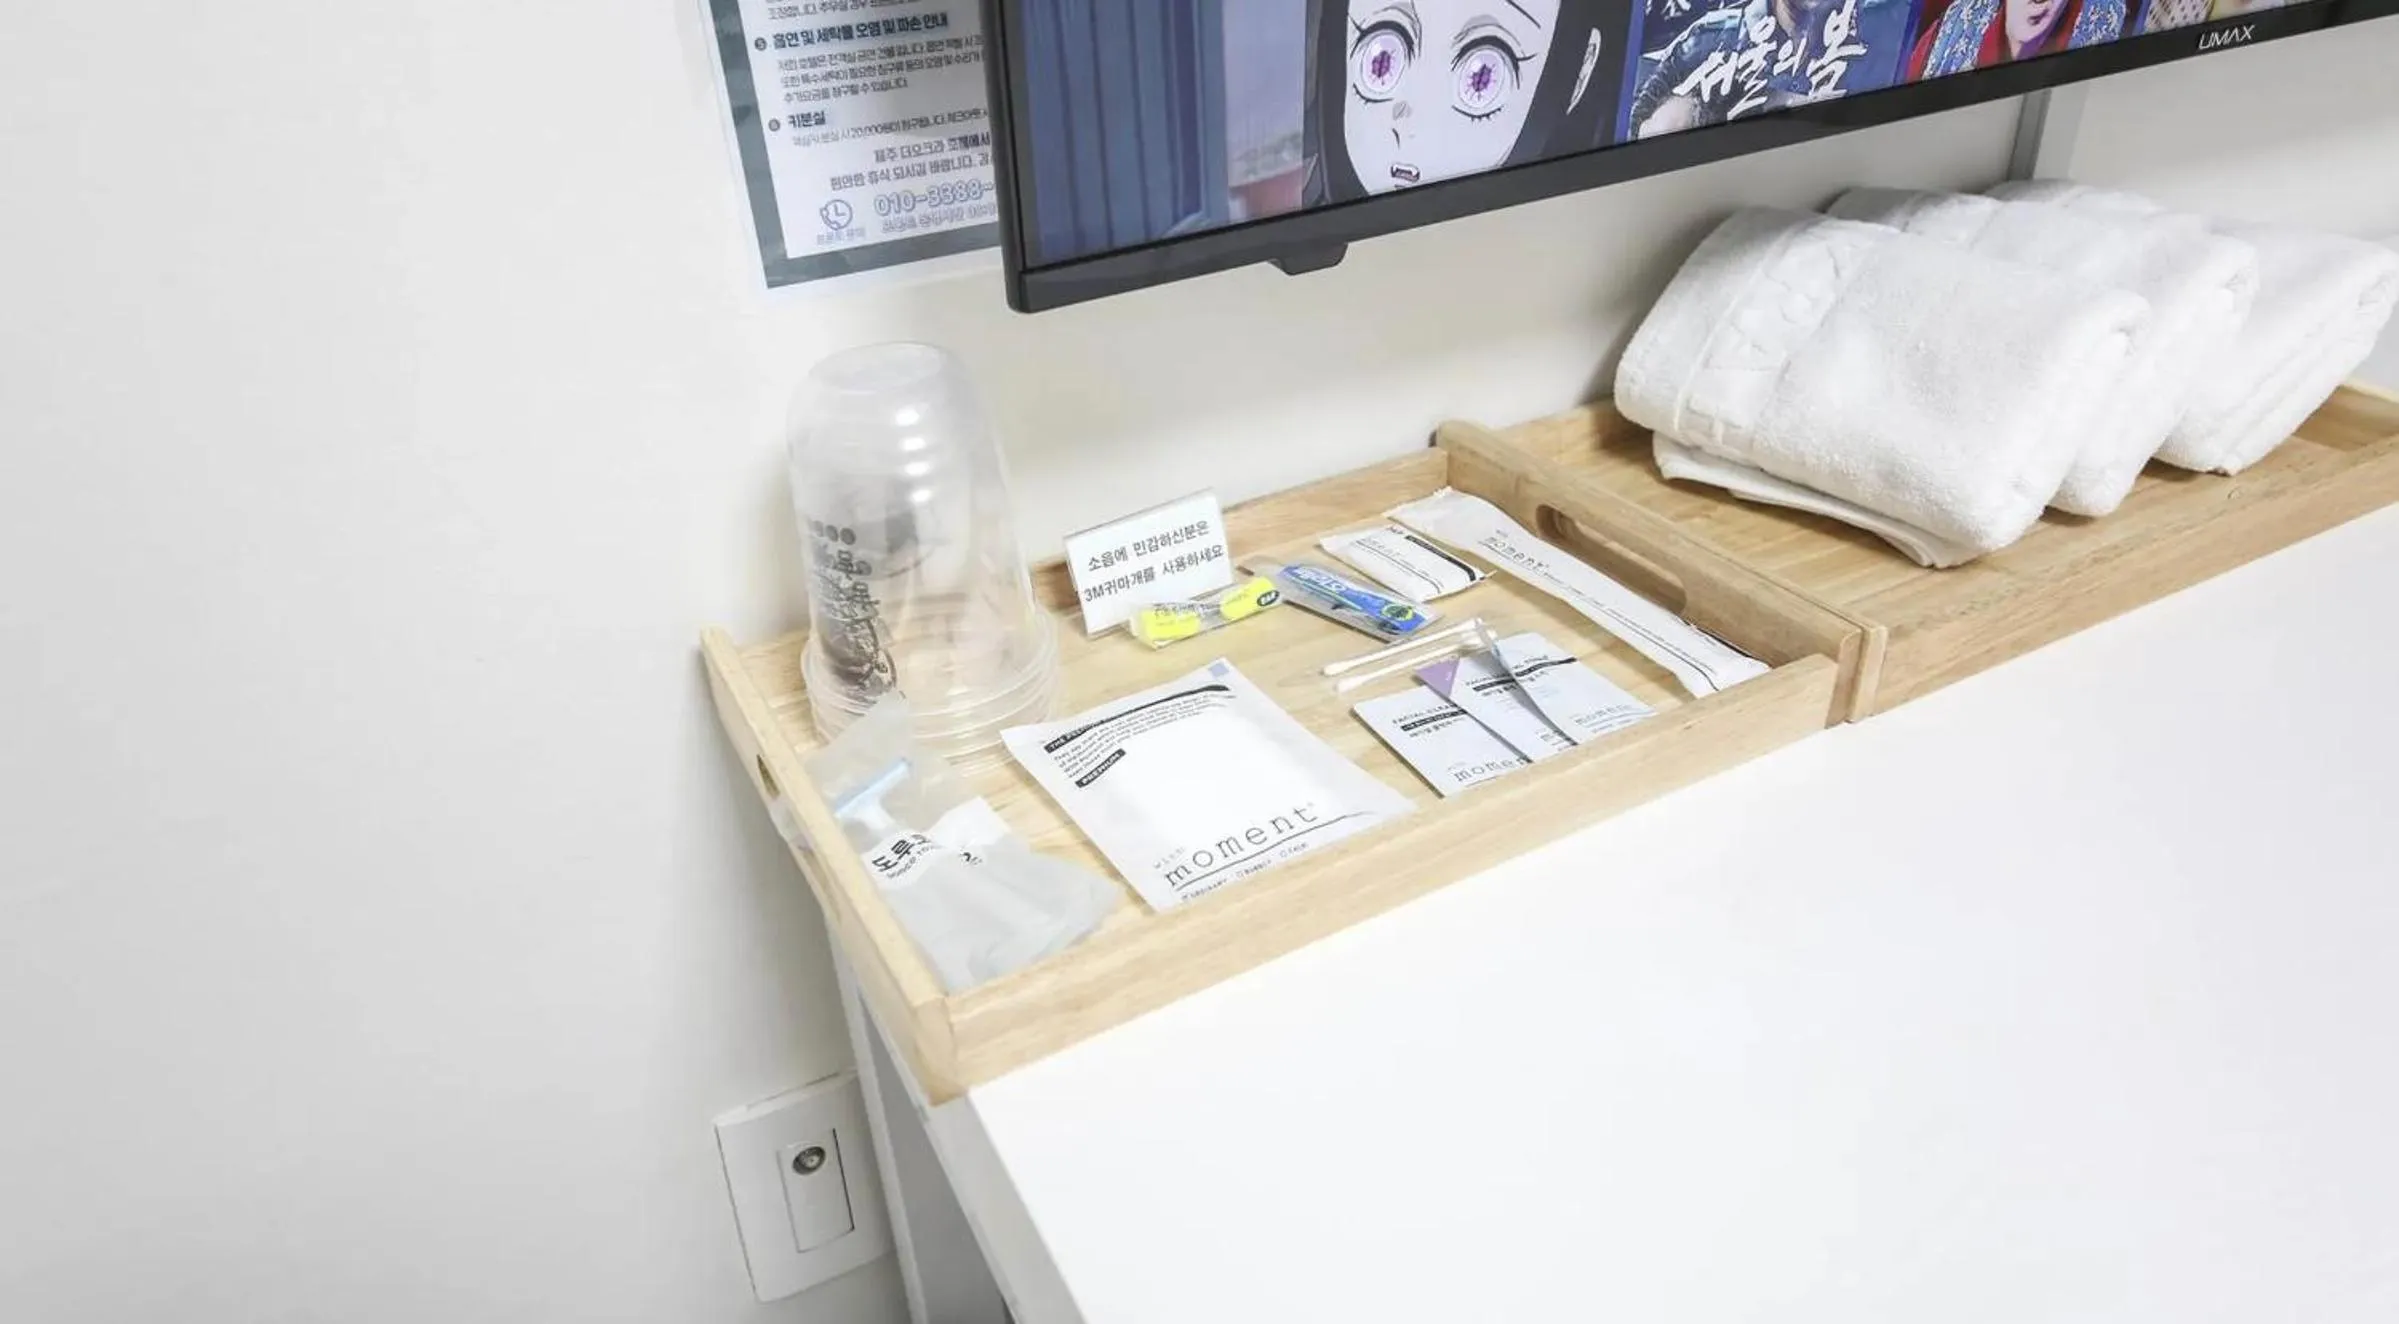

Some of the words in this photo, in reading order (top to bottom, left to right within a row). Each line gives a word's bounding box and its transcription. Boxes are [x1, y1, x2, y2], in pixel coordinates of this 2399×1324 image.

[856, 21, 881, 38] 오염
[897, 15, 922, 32] 파손
[923, 10, 948, 29] 안내
[2198, 24, 2256, 50] UMAX
[788, 110, 826, 129] 키분실
[874, 147, 898, 163] 제주
[830, 172, 865, 191] 편안한
[1088, 546, 1129, 572] 소음에
[1132, 520, 1211, 557] 민감하신분은
[1083, 566, 1156, 602] 3M귀마개를
[1162, 544, 1224, 575] 사용하세요
[1164, 806, 1319, 887] moment
